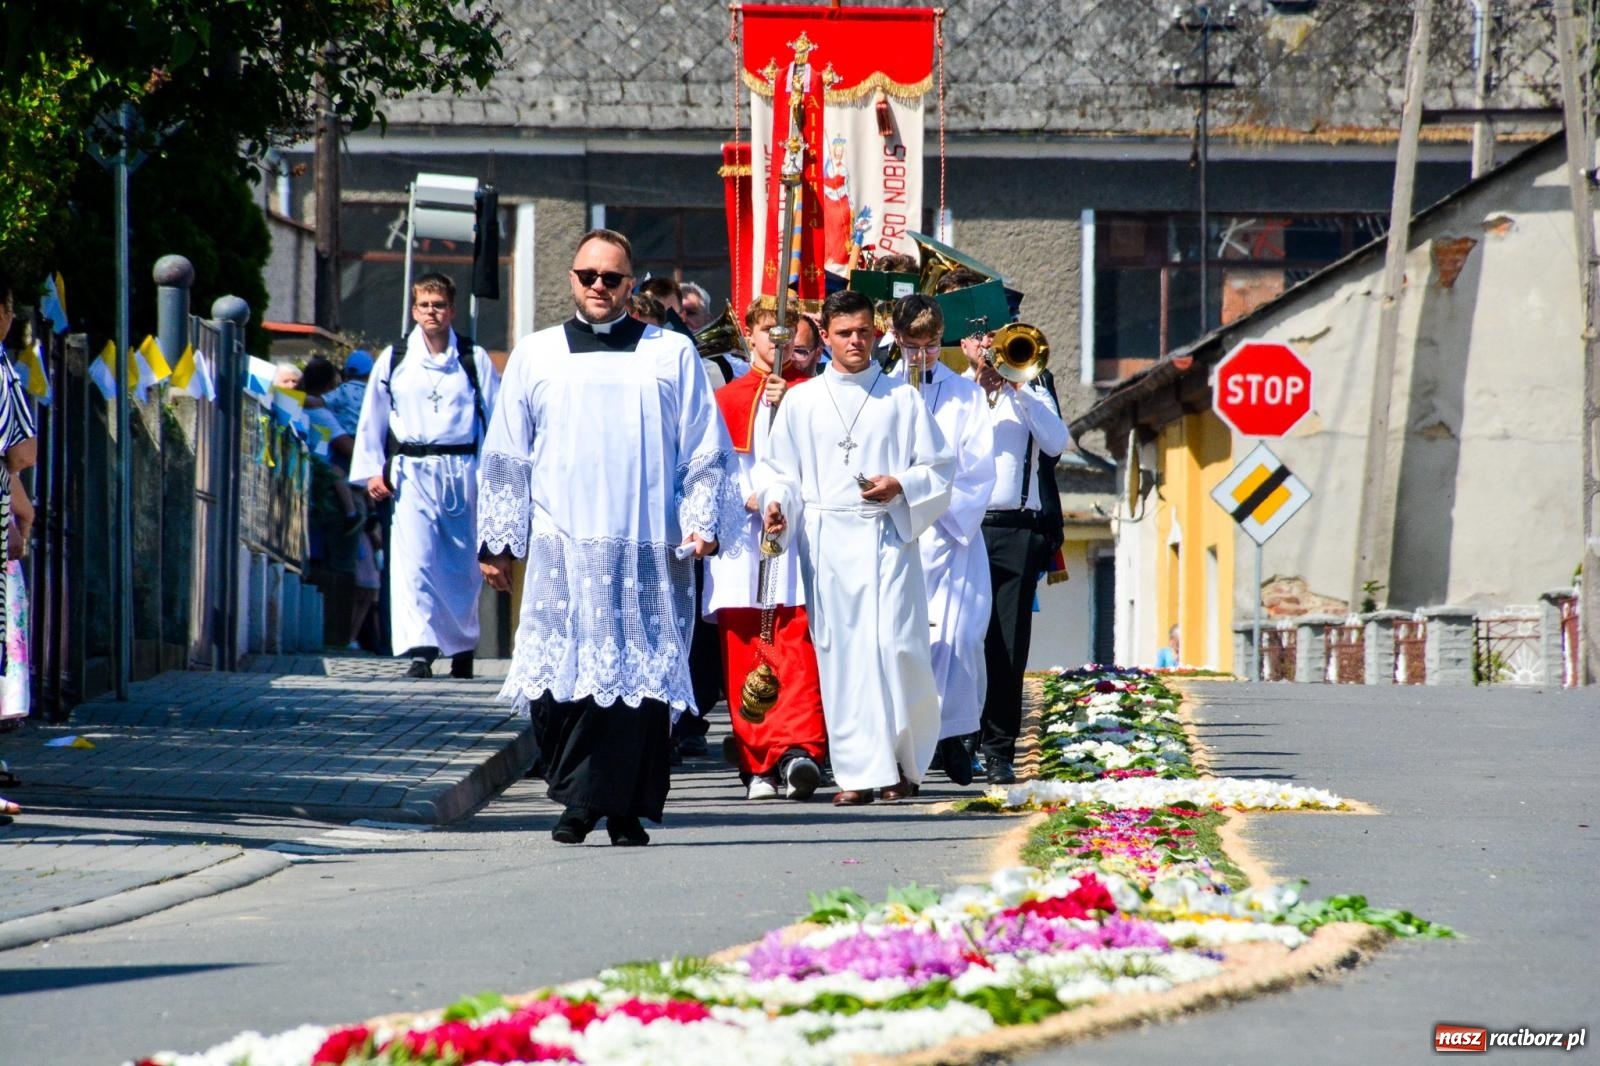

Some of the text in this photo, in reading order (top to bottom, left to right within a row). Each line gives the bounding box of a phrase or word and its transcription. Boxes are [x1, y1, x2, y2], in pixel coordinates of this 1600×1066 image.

[879, 144, 906, 255] PRO NOBIS
[1226, 374, 1304, 405] STOP
